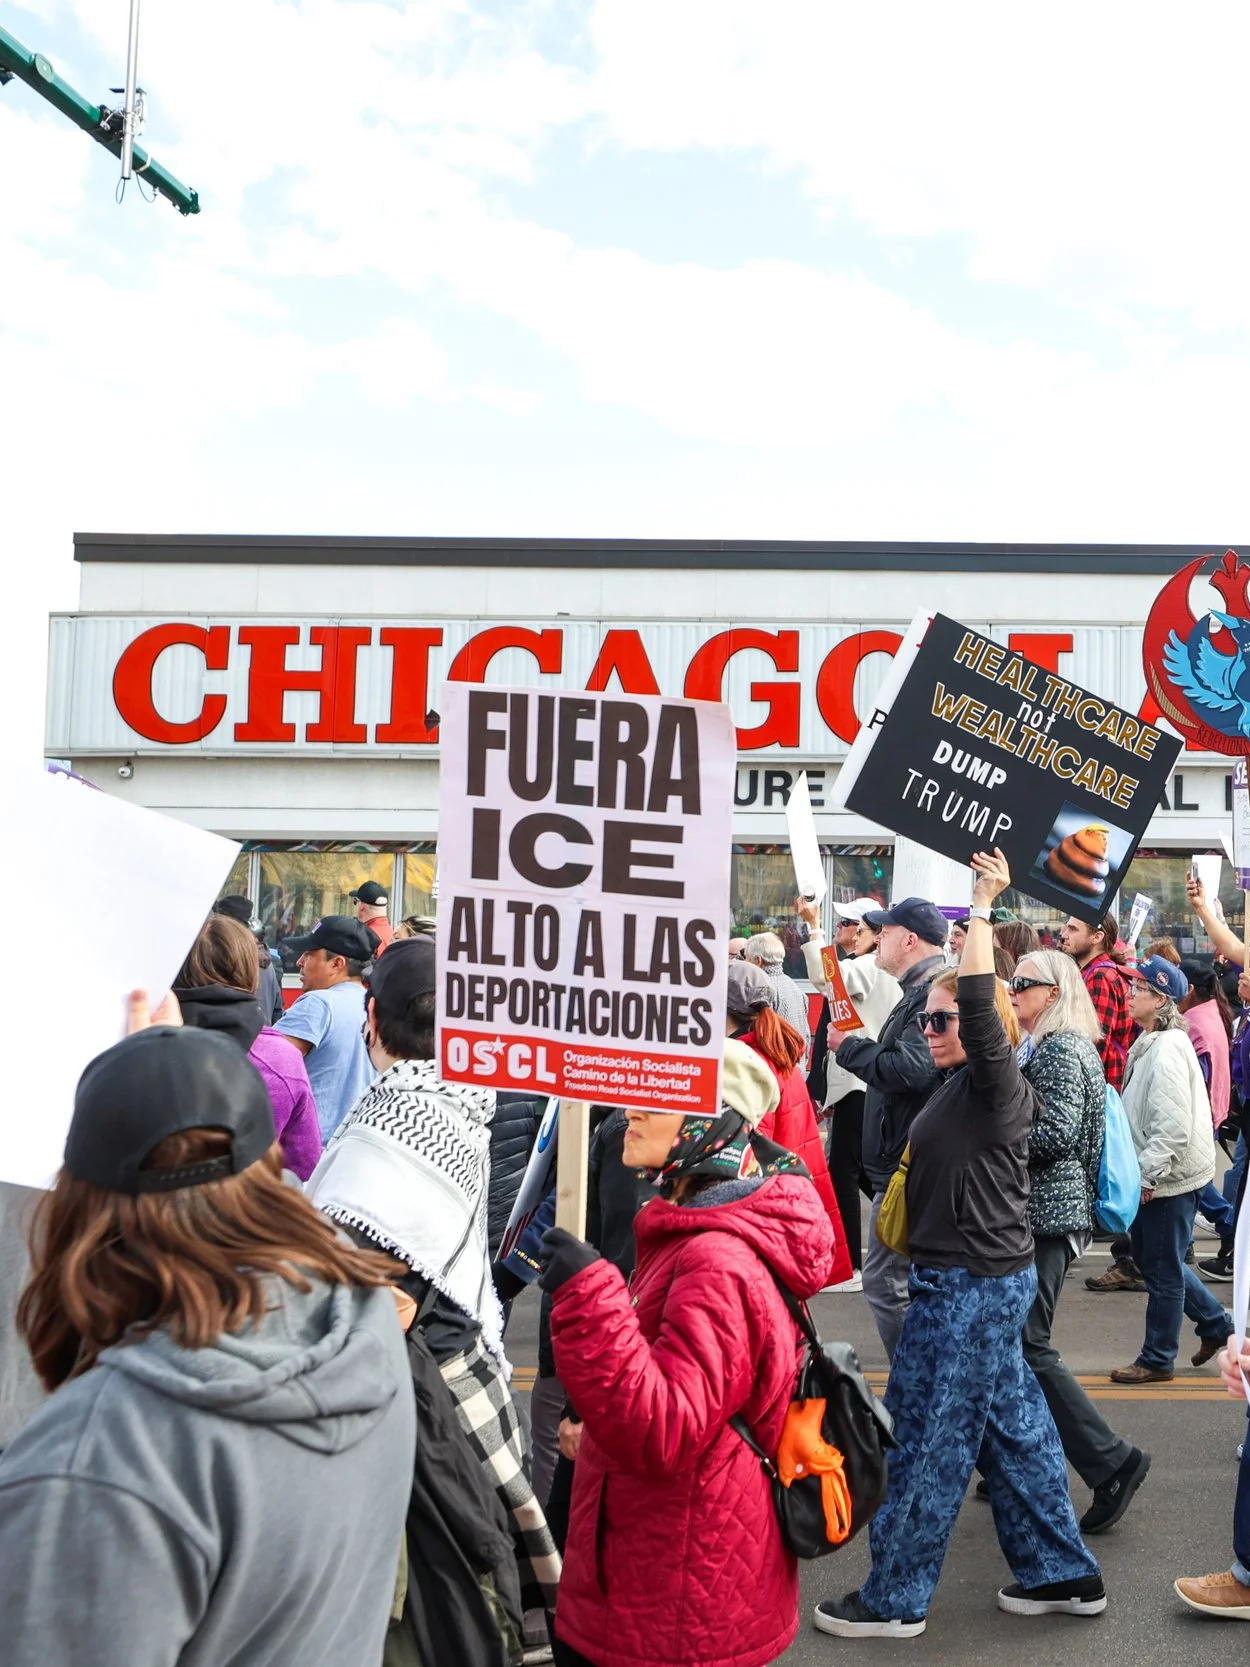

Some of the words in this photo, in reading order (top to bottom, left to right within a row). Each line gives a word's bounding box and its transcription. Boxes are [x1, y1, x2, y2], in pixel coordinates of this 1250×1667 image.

[953, 631, 1162, 761] HEALTHCARE
[1017, 700, 1056, 733] not
[466, 689, 702, 815] FUERA
[931, 681, 1139, 810] WEALTHCARE
[932, 740, 1008, 790] DUMP
[901, 768, 1013, 843] TRUMP
[471, 807, 686, 900] ICE
[447, 896, 560, 972] ALTO
[573, 908, 616, 978] A
[622, 913, 716, 988] LAS
[445, 971, 713, 1047] DEPORTACIONES
[831, 1000, 852, 1022] LIES
[563, 1050, 640, 1070] Organización
[641, 1058, 702, 1076] Socialista
[563, 1065, 608, 1082] Camino
[609, 1070, 626, 1084] de
[627, 1072, 639, 1085] la
[640, 1074, 691, 1091] Libertad
[564, 1080, 598, 1093] Freedom
[599, 1085, 619, 1095] Road
[619, 1087, 652, 1098] Socialist
[652, 1091, 702, 1103] Organization
